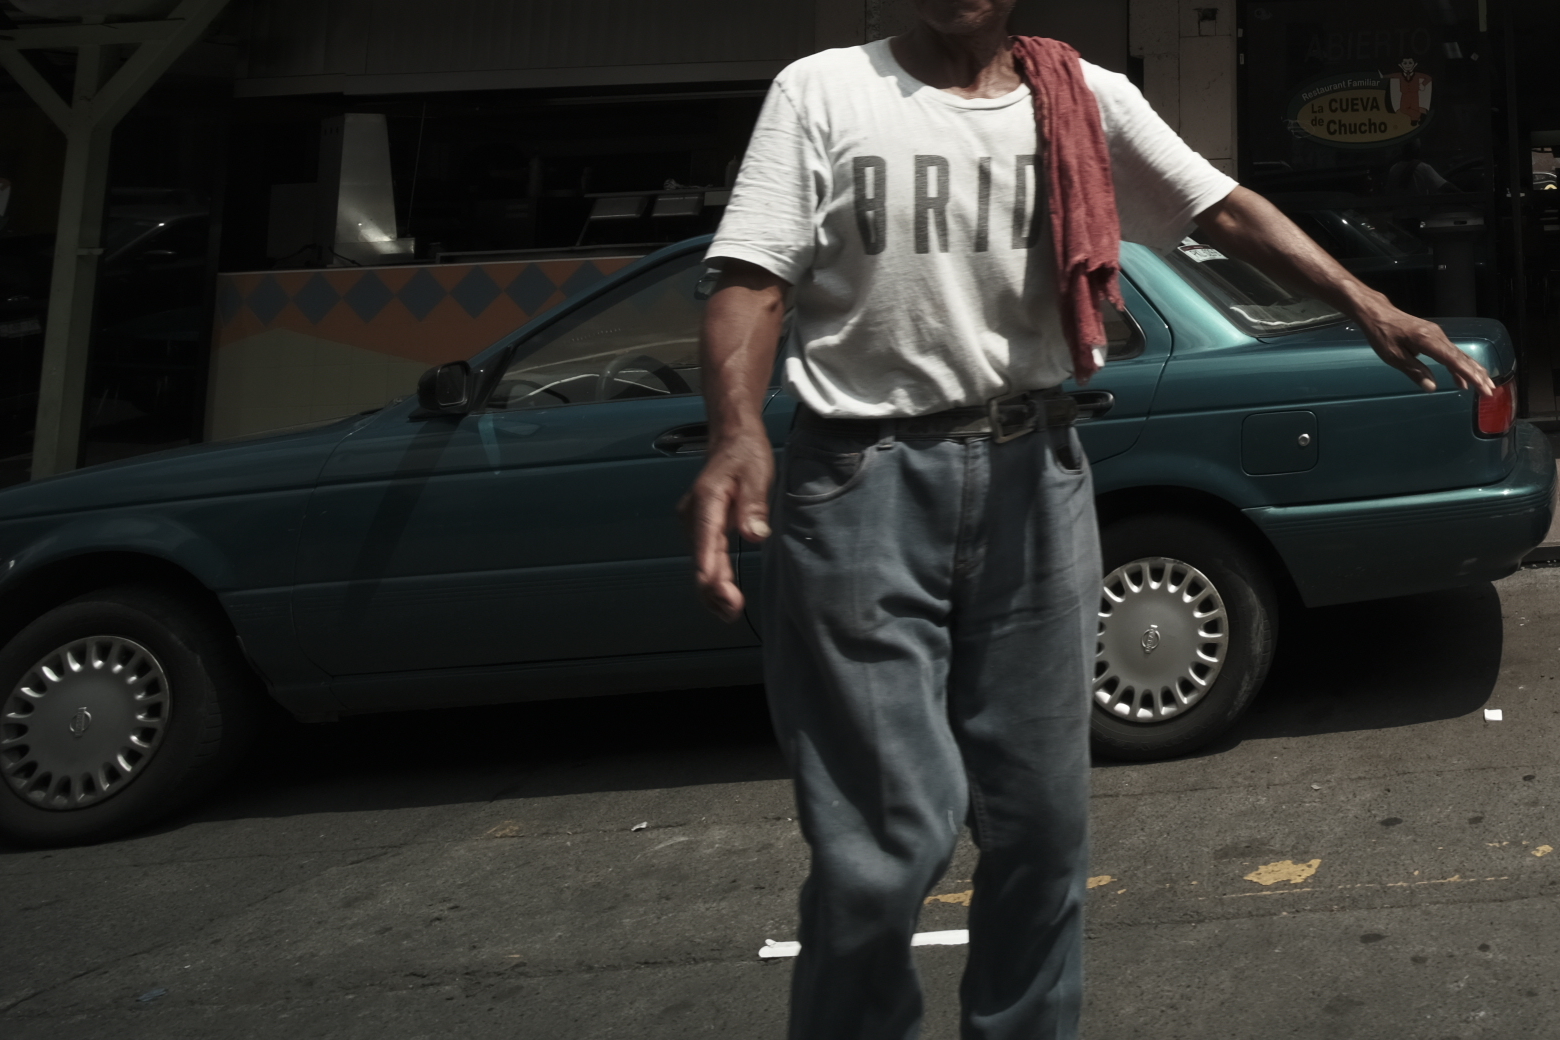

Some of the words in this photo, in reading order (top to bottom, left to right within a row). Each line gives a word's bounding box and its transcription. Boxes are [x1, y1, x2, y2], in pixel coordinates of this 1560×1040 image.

[1304, 27, 1432, 63] ABIERTO
[1301, 80, 1347, 102] Restaurant
[1347, 79, 1381, 89] Familiar
[1311, 103, 1324, 114] La
[1328, 96, 1381, 113] CUEVA
[1311, 116, 1325, 128] de
[1326, 119, 1388, 136] Chucho
